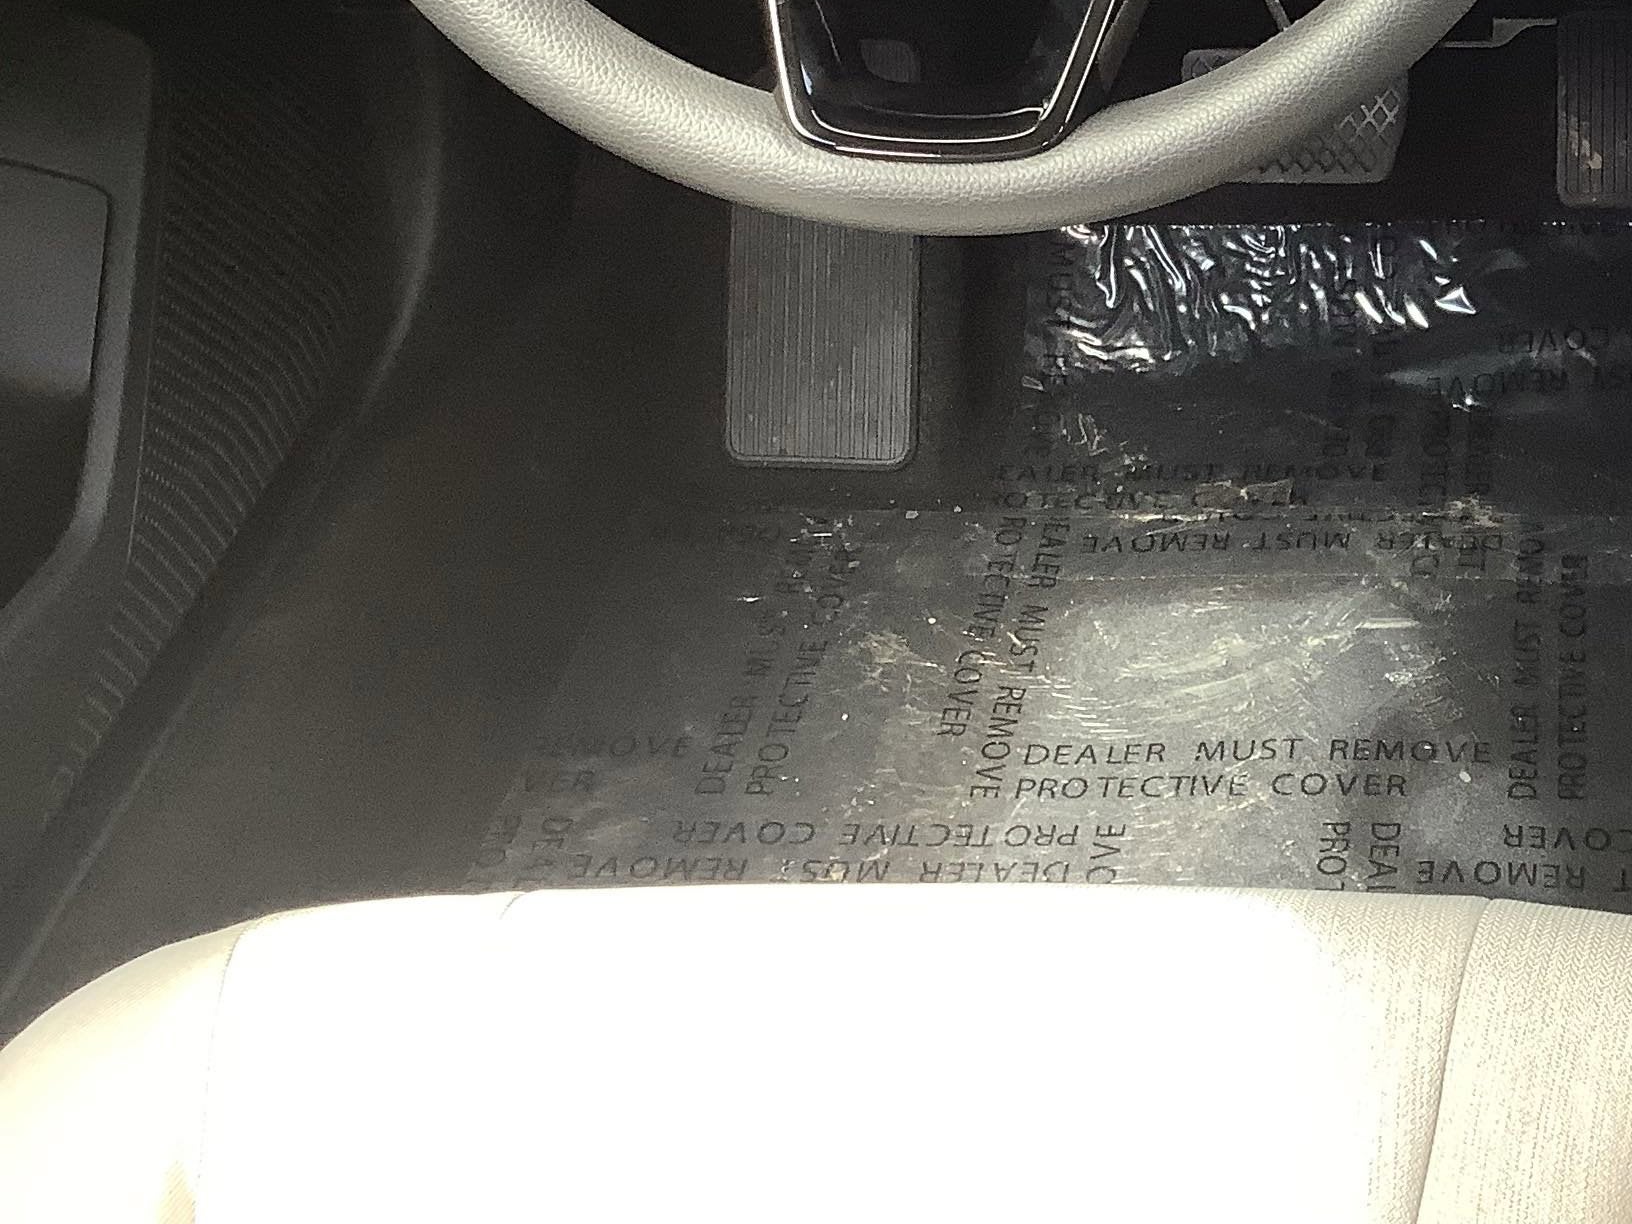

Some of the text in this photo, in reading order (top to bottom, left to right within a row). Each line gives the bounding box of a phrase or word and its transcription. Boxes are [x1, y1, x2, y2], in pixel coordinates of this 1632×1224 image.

[937, 649, 986, 737] COVER
[744, 641, 829, 797] PROTECTIVE
[969, 685, 1027, 799] REMOVE
[1023, 737, 1491, 766] DEALER MUST REMOVE
[1014, 773, 1408, 801] PROTECTIVE COVER
[672, 820, 1079, 848] PROTECTIVE COVER
[1416, 859, 1586, 891] REMOVE
